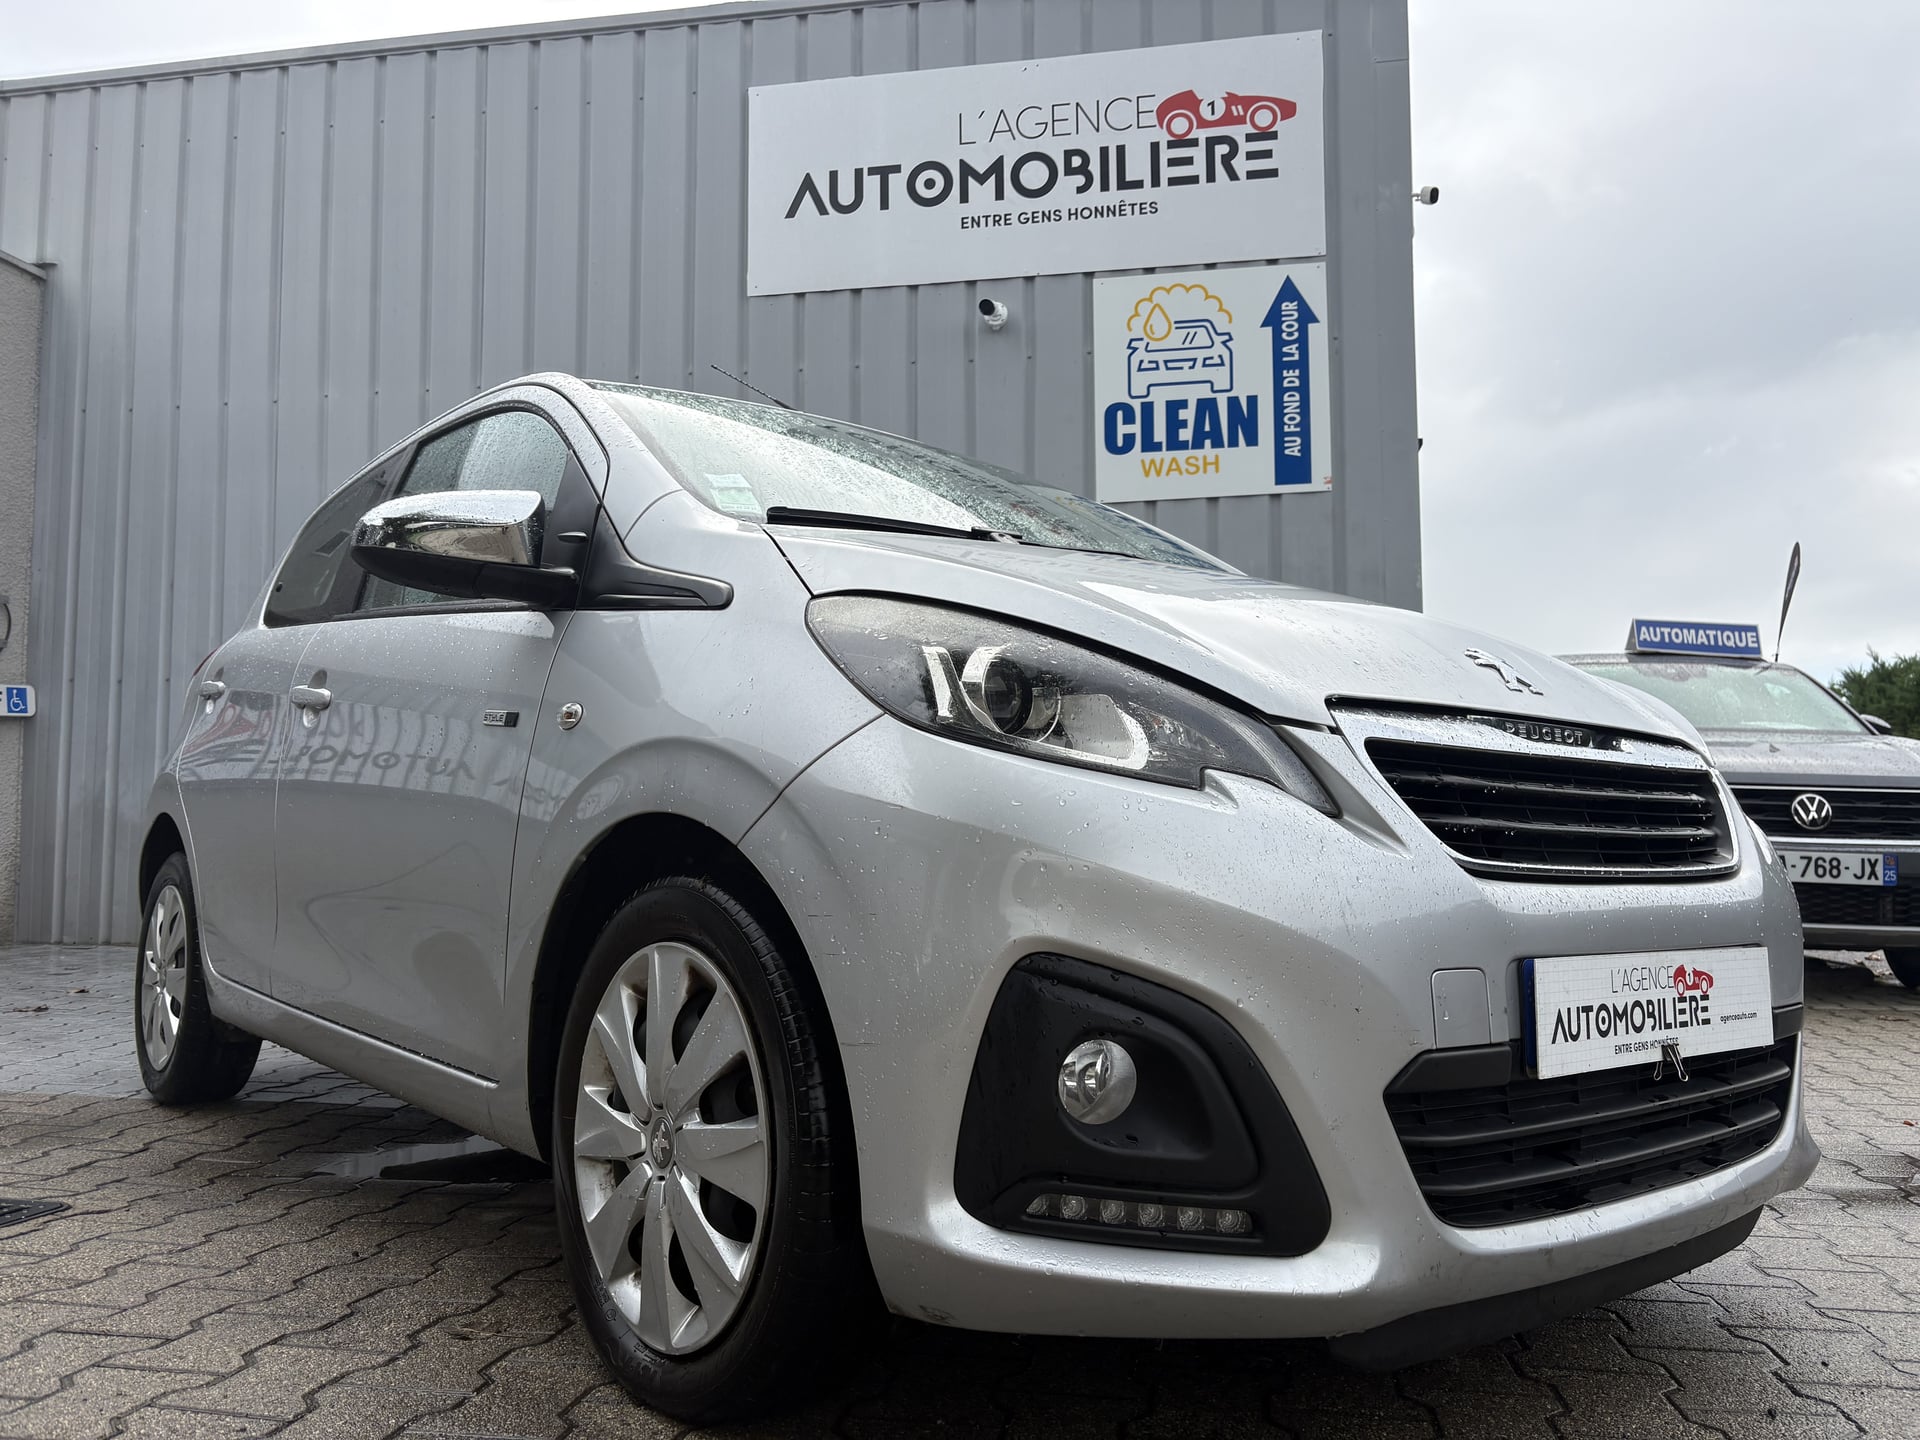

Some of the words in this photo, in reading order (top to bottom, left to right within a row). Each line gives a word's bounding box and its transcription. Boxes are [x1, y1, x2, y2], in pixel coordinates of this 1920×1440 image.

[958, 94, 1158, 145] L'AGENCE
[1207, 100, 1217, 116] 1
[784, 131, 1279, 219] AUTOMOBILIERE
[960, 212, 1013, 230] ENTRE
[1017, 208, 1063, 225] GENS
[1067, 200, 1159, 222] HONNÊTES
[1281, 300, 1298, 340] COUR
[1282, 343, 1299, 361] LA
[1283, 369, 1299, 388] DE
[1283, 391, 1301, 432] FOND
[1104, 395, 1259, 456] CLEAN
[1284, 436, 1302, 457] AU
[1140, 454, 1221, 478] WASH
[1639, 626, 1759, 648] AUTOMATIQUE
[1505, 722, 1583, 744] PEUGEOT
[1884, 870, 1897, 881] 25
[1610, 965, 1675, 994] L'AGENCE
[1551, 994, 1711, 1045] AUTOMOBILIERE
[1719, 1011, 1758, 1025] agenceauto.com
[1614, 1042, 1633, 1055] ENTRE
[1634, 1040, 1649, 1052] GENS
